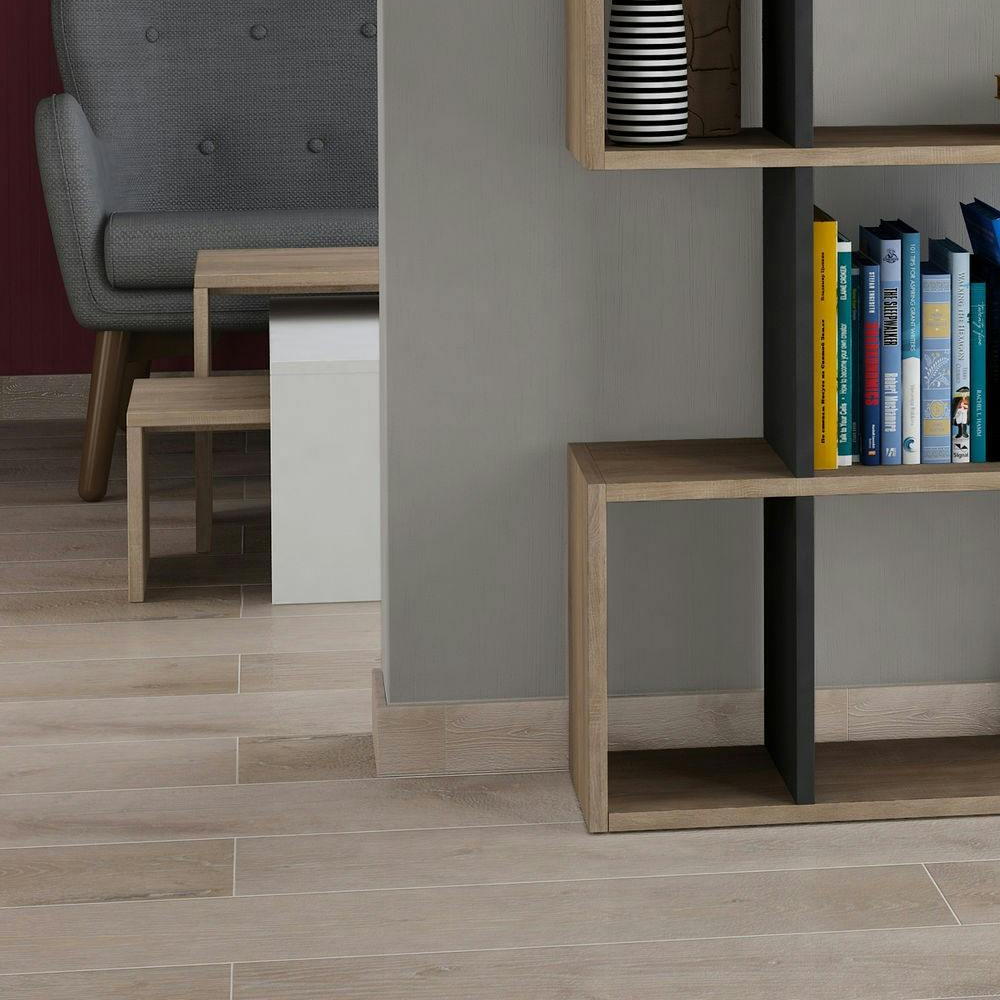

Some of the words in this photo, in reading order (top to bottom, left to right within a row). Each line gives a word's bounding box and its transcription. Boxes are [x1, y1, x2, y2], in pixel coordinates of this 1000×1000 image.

[883, 287, 898, 300] THE
[883, 301, 898, 346] SLEEPWALKER
[885, 373, 898, 394] Robert
